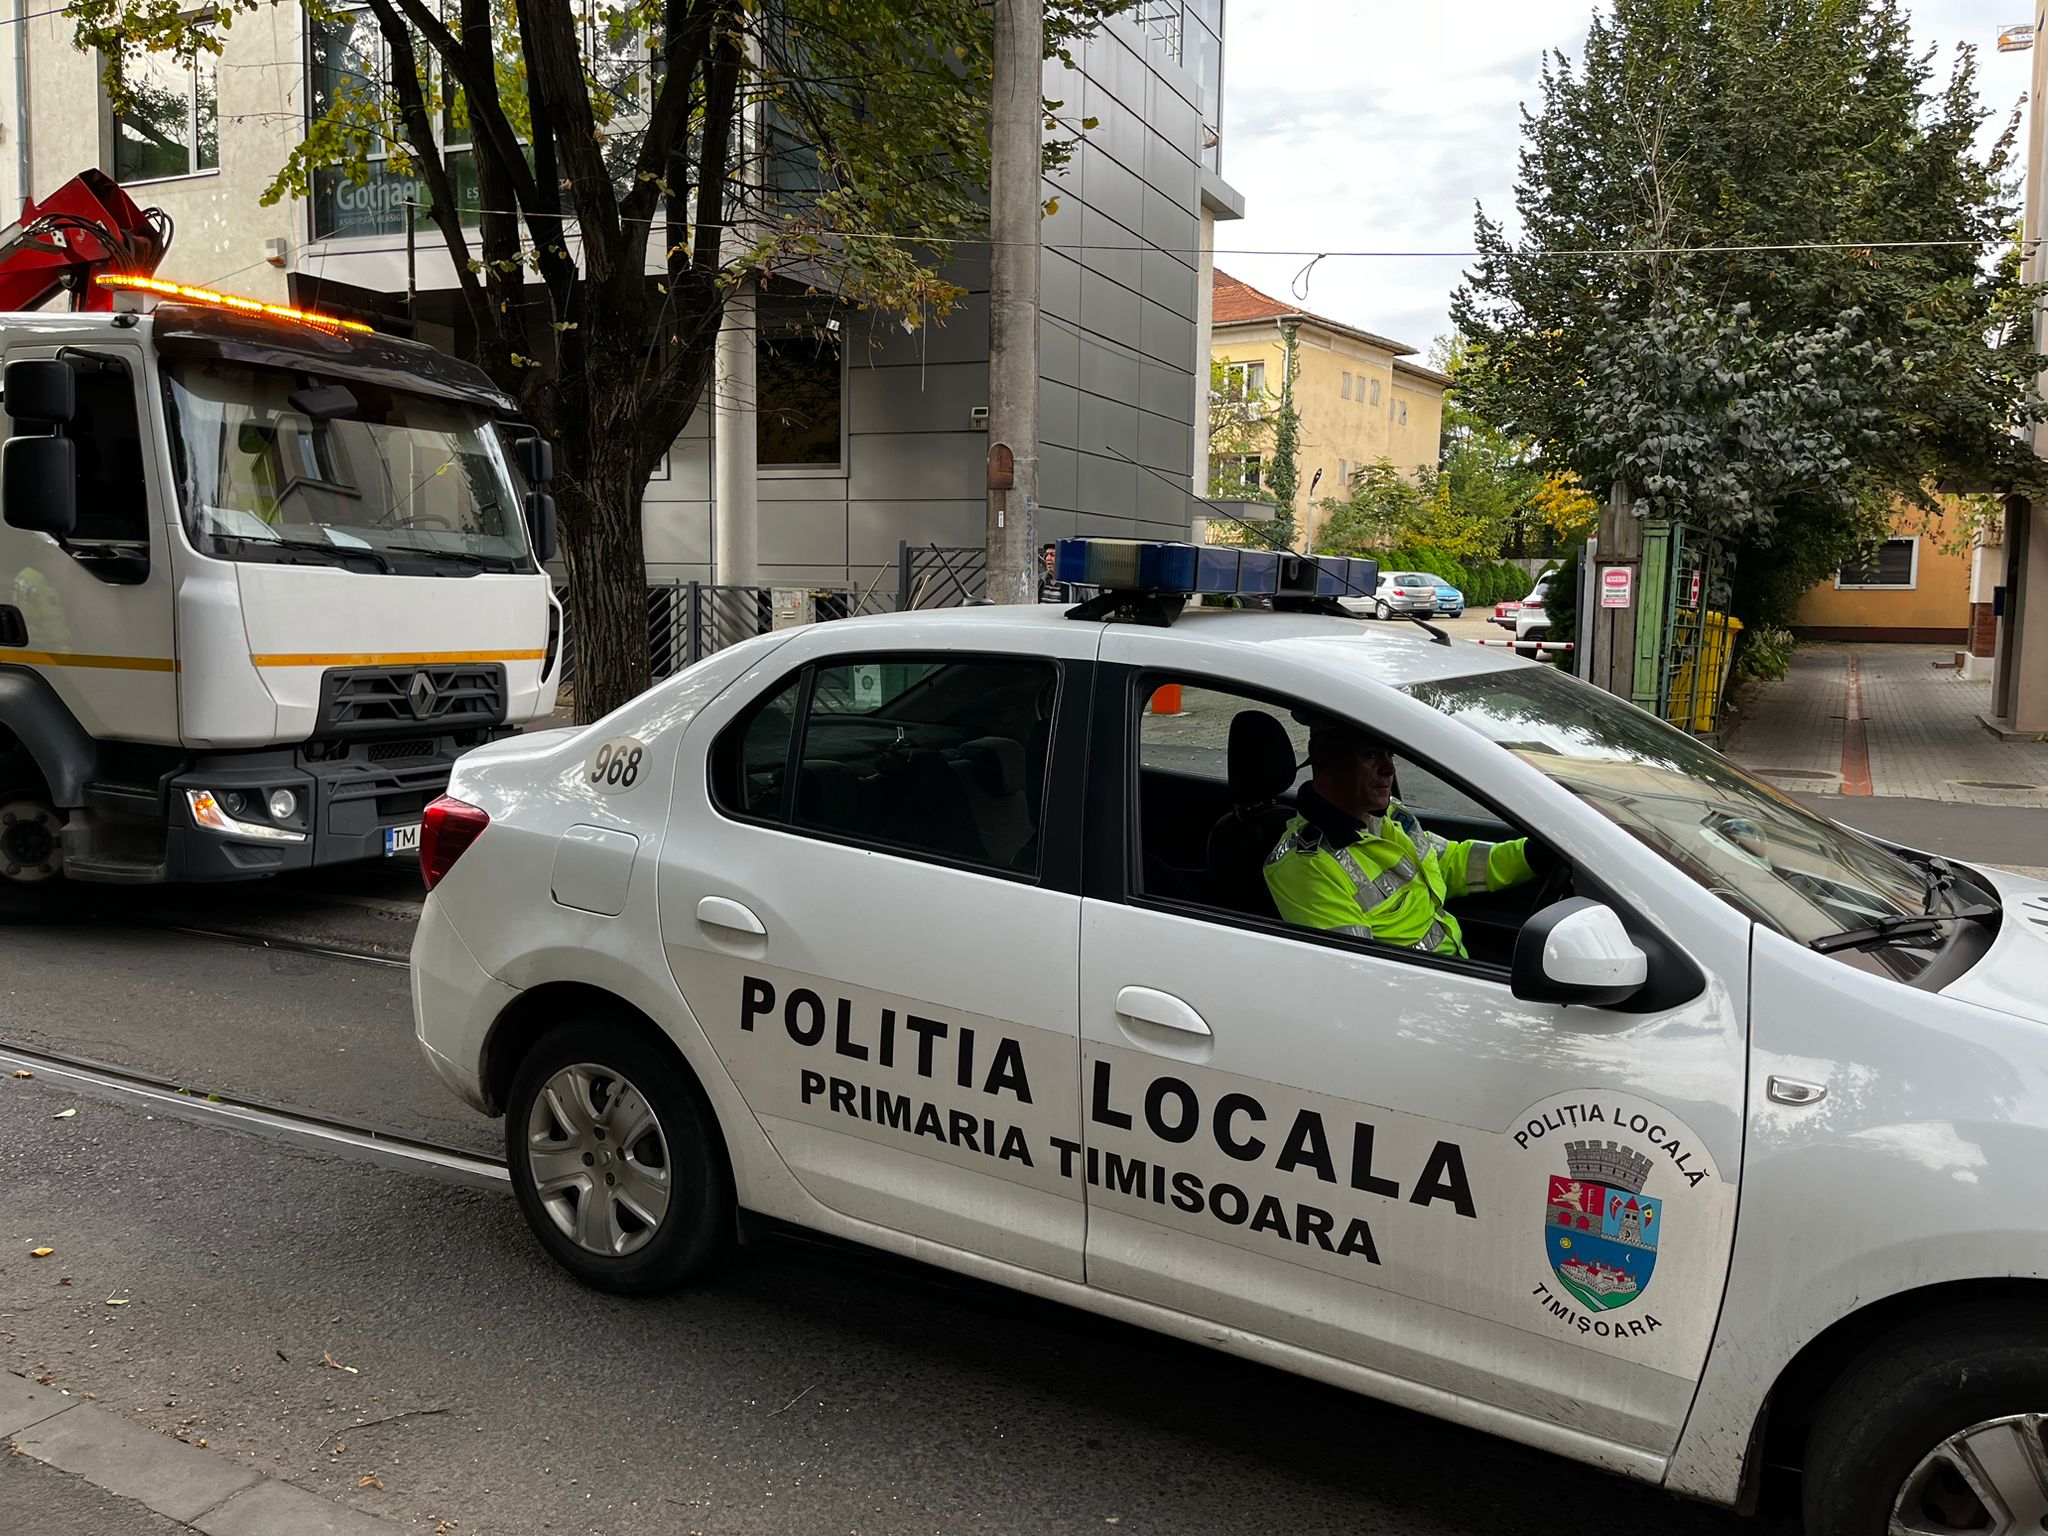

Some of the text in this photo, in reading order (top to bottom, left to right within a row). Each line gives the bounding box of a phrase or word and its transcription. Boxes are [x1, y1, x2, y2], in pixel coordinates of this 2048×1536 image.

[337, 175, 424, 211] Gothaer
[591, 744, 643, 787] 968
[394, 827, 415, 848] TM
[741, 975, 1478, 1219] POLITIA LOCALA
[801, 1069, 1381, 1266] PRIMARIA TIMISOARA
[1513, 1104, 1710, 1188] POLIȚIA LOCALĂ
[1532, 1282, 1663, 1338] TIMIȘOARA
